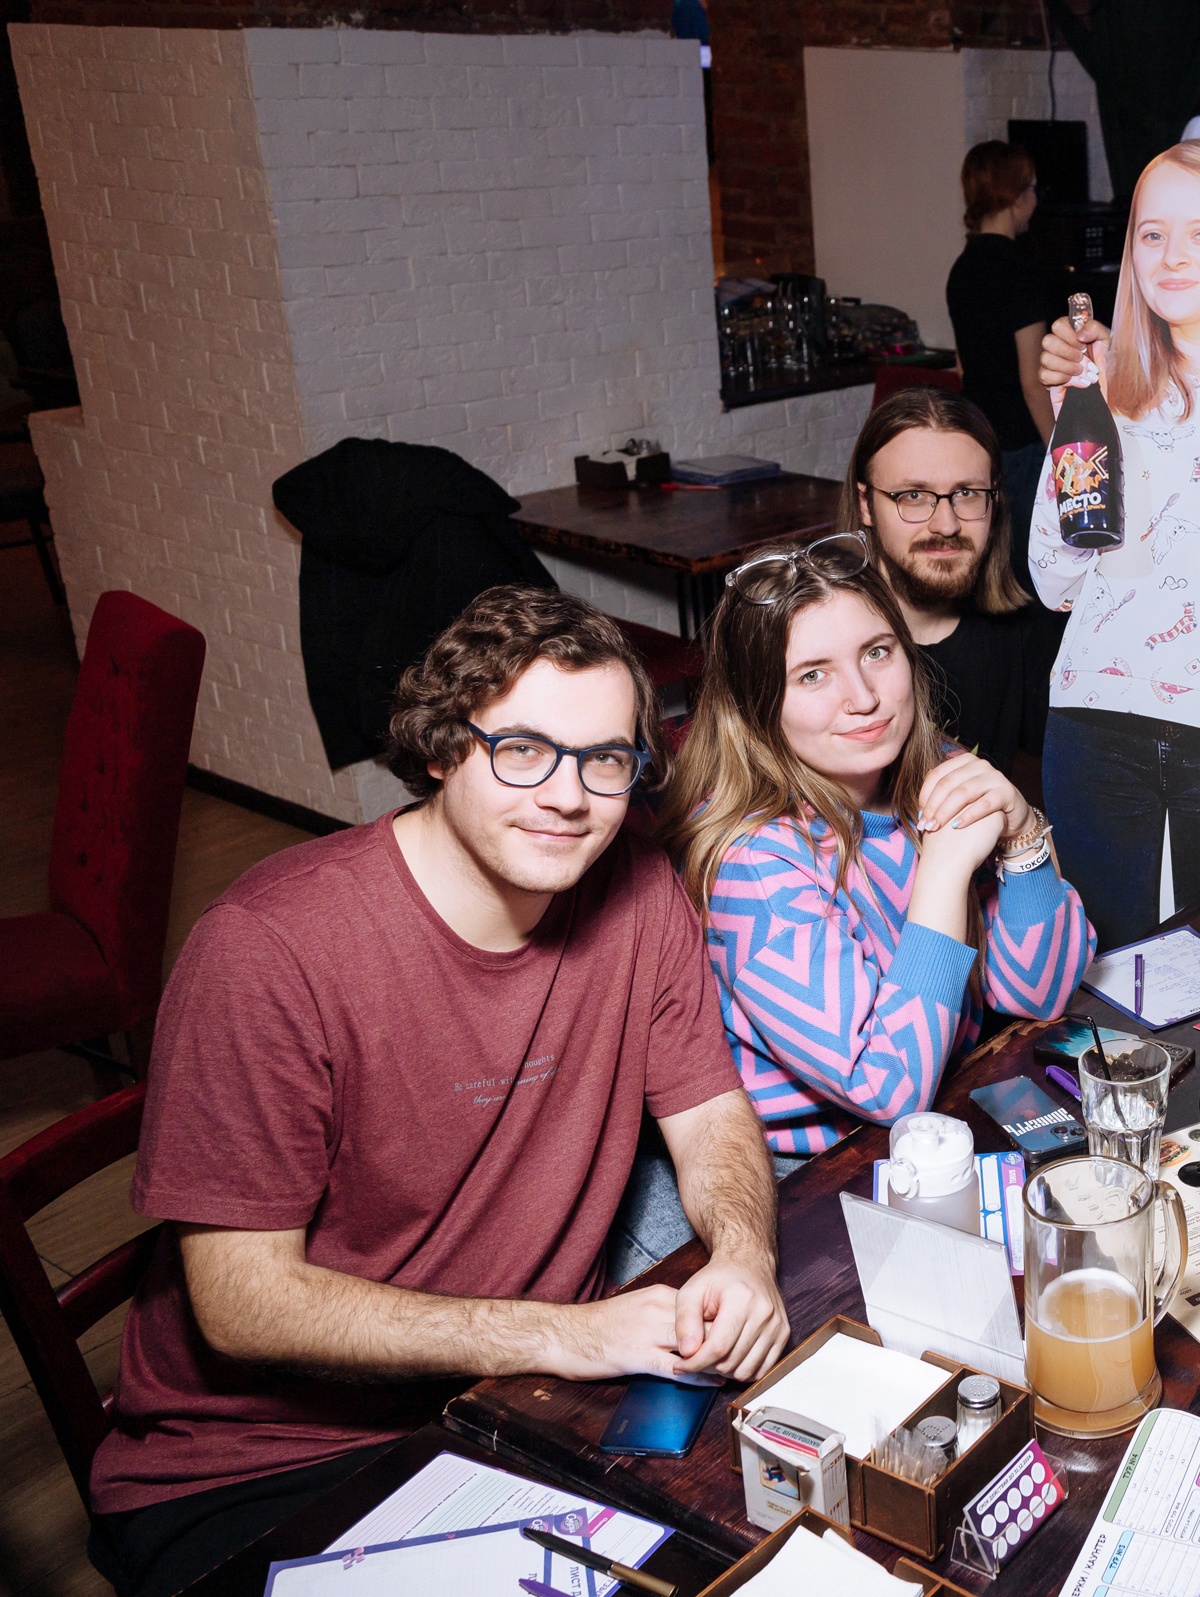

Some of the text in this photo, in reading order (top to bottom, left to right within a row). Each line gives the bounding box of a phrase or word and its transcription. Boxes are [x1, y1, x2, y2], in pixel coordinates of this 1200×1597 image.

[1059, 491, 1102, 514] МЕСТО
[1019, 850, 1049, 871] ТОКСИК
[524, 1054, 556, 1069] houghts
[465, 1077, 496, 1091] careful
[500, 1075, 514, 1086] wit
[1121, 1452, 1139, 1479] ТУР №4
[977, 1498, 990, 1512] СРОК
[987, 1477, 1009, 1502] ДЕЙСТВИЯ
[1007, 1472, 1015, 1481] ДО
[1071, 1575, 1088, 1597] ЕРКИ
[1084, 1532, 1108, 1569] КАУНТЕР
[1108, 1543, 1126, 1569] ТУР №3
[569, 1566, 581, 1589] ЛИСТ
